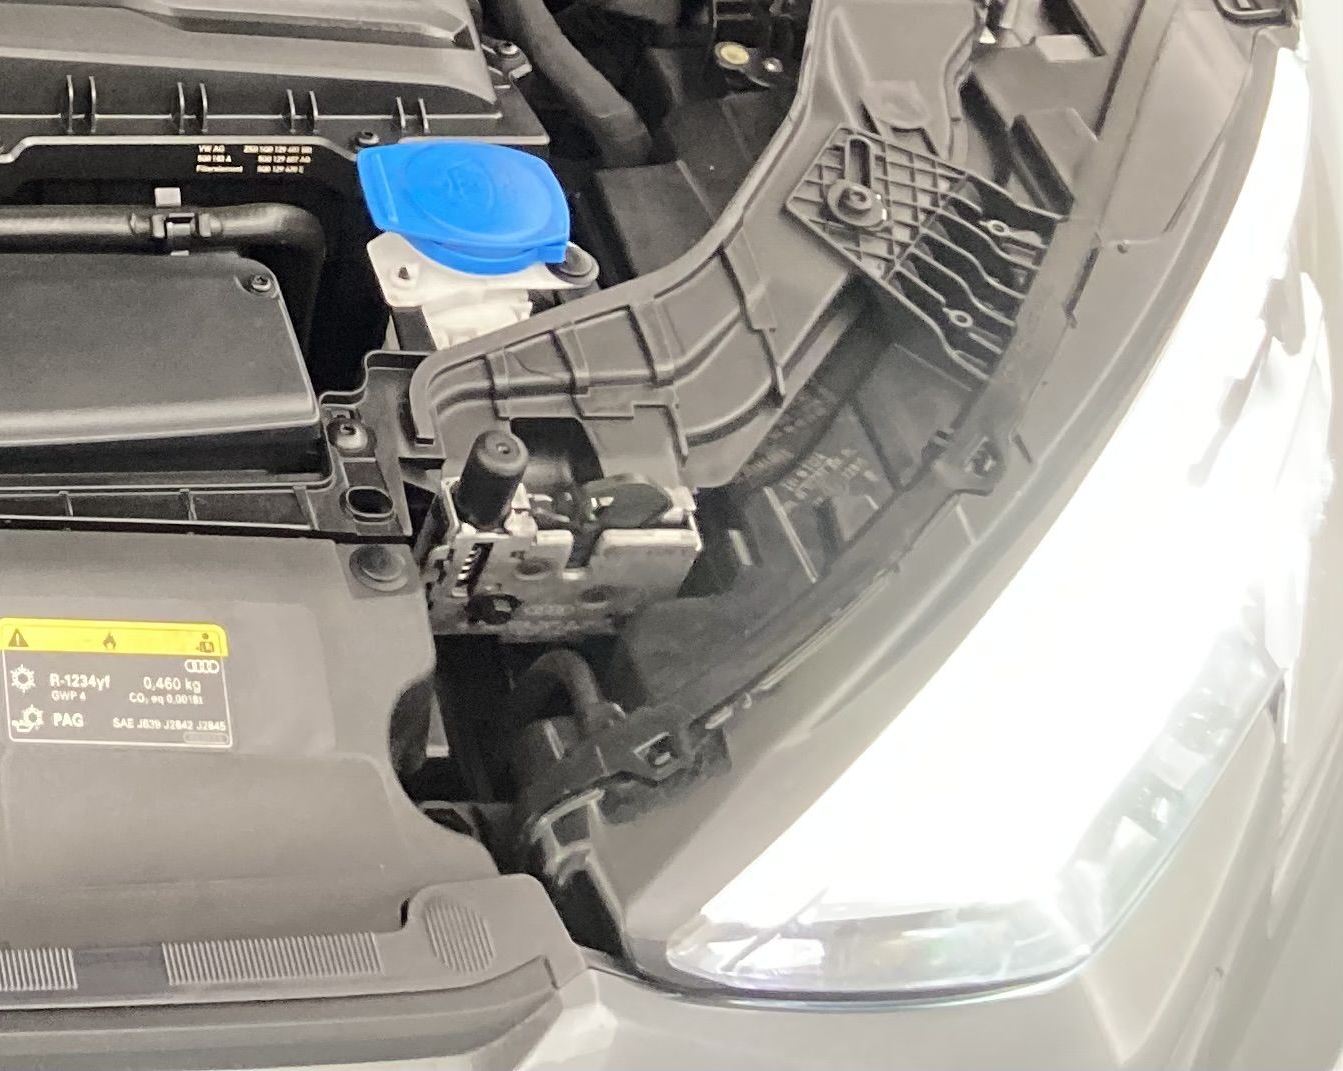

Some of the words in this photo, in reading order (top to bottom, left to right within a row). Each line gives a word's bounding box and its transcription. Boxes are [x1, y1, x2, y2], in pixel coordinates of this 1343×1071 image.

[49, 673, 111, 691] R-1234yf
[143, 676, 181, 691] 0,460
[185, 678, 201, 694] kg
[51, 691, 77, 702] GWP
[151, 695, 165, 706] eq
[53, 713, 84, 728] PAG
[113, 717, 134, 729] SAE
